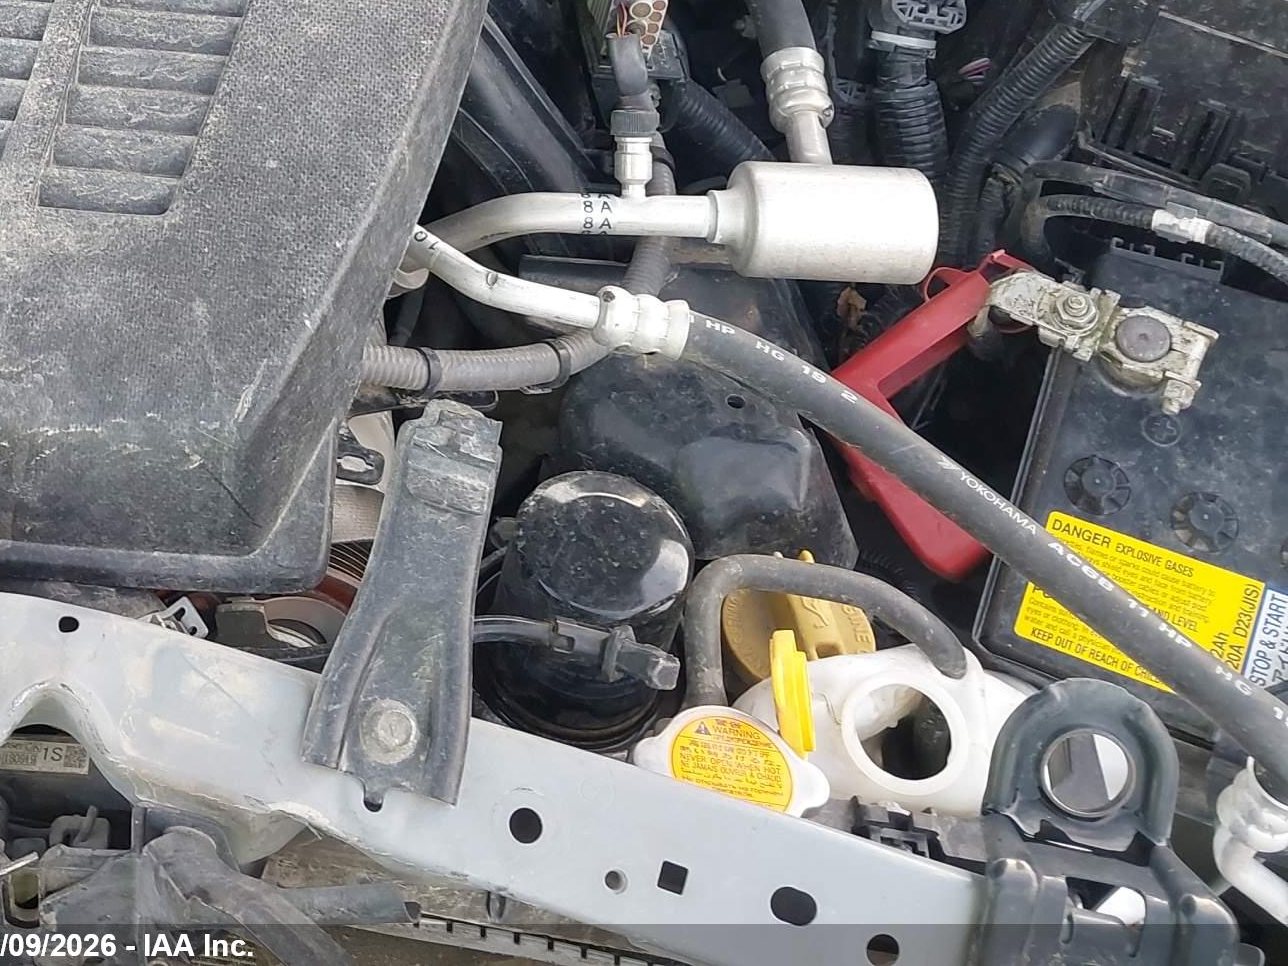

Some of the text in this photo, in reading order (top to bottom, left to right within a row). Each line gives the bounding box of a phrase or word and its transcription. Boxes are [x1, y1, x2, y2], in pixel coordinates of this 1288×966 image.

[705, 319, 736, 335] HP
[960, 473, 1037, 535] YOKOHAMA
[1052, 519, 1111, 549] DANGER
[1115, 542, 1163, 567] EXPLOSIVE
[1165, 559, 1195, 578] GASES
[1172, 614, 1199, 633] LEVEL
[1233, 583, 1262, 638] D23(JIS)
[1031, 626, 1054, 642] KEEP
[1055, 636, 1073, 650] OUT
[1075, 644, 1086, 656] OF
[1088, 648, 1119, 667] REACH
[1121, 660, 1133, 673] OF
[1249, 594, 1288, 687] STOP & START
[712, 724, 761, 740] WARNING
[712, 757, 734, 768] OPEN
[736, 761, 761, 773] WHEN
[764, 766, 781, 775] HOT
